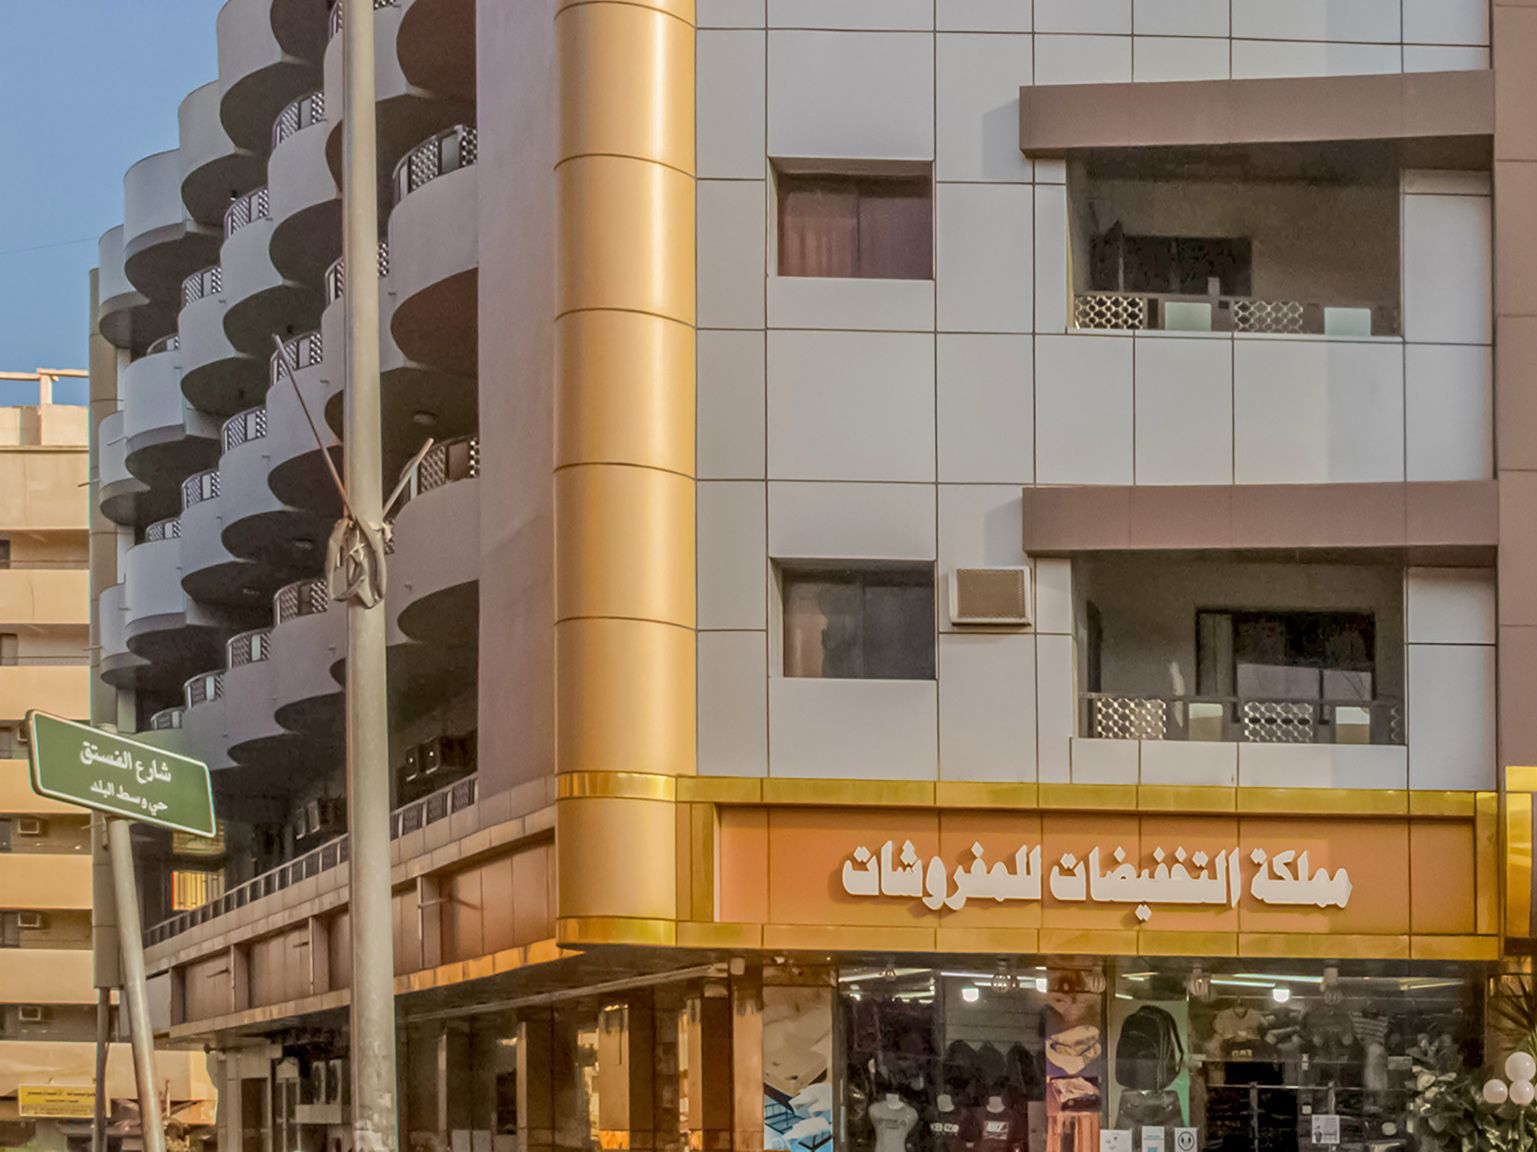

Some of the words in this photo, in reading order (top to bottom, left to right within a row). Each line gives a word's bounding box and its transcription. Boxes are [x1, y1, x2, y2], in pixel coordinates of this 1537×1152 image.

[80, 741, 132, 769] الفستق
[135, 759, 172, 784] شارع
[90, 779, 115, 798] البلد
[116, 785, 148, 809] وسط
[148, 800, 168, 817] حي
[842, 839, 1042, 910] للمفروشات
[1049, 846, 1241, 922] التخفيضات
[1250, 847, 1353, 909] مملكة
